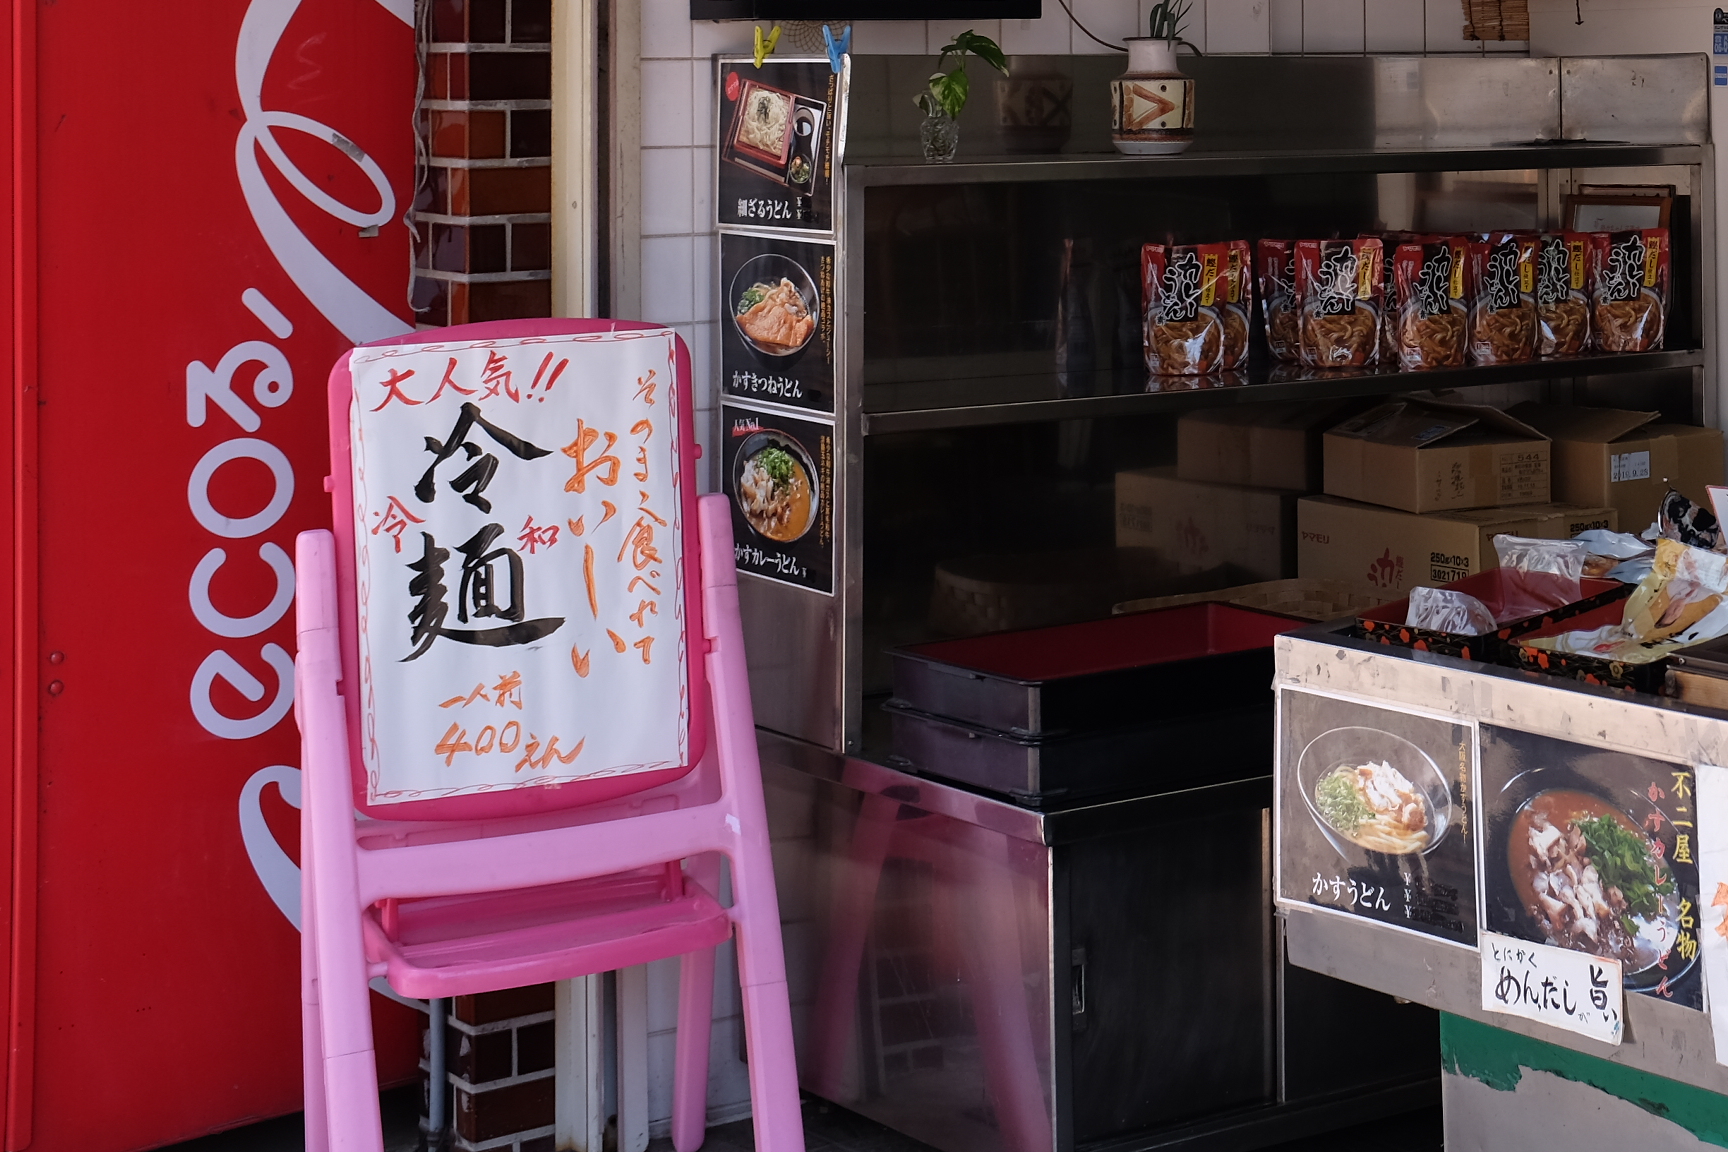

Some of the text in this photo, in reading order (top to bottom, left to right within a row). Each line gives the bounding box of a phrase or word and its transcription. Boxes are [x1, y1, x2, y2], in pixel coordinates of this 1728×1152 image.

[737, 198, 792, 220] 細ざるうどん
[732, 370, 803, 398] かすきつねうどん
[397, 402, 566, 662] 冷麺
[735, 542, 800, 576] かすカレーうどん
[437, 670, 524, 711] 一人前
[1670, 771, 1697, 960] 不二屋 名物
[1311, 871, 1392, 913] かすうどん
[1644, 781, 1674, 999] かすカレーうどん
[1492, 942, 1537, 968] とにかく
